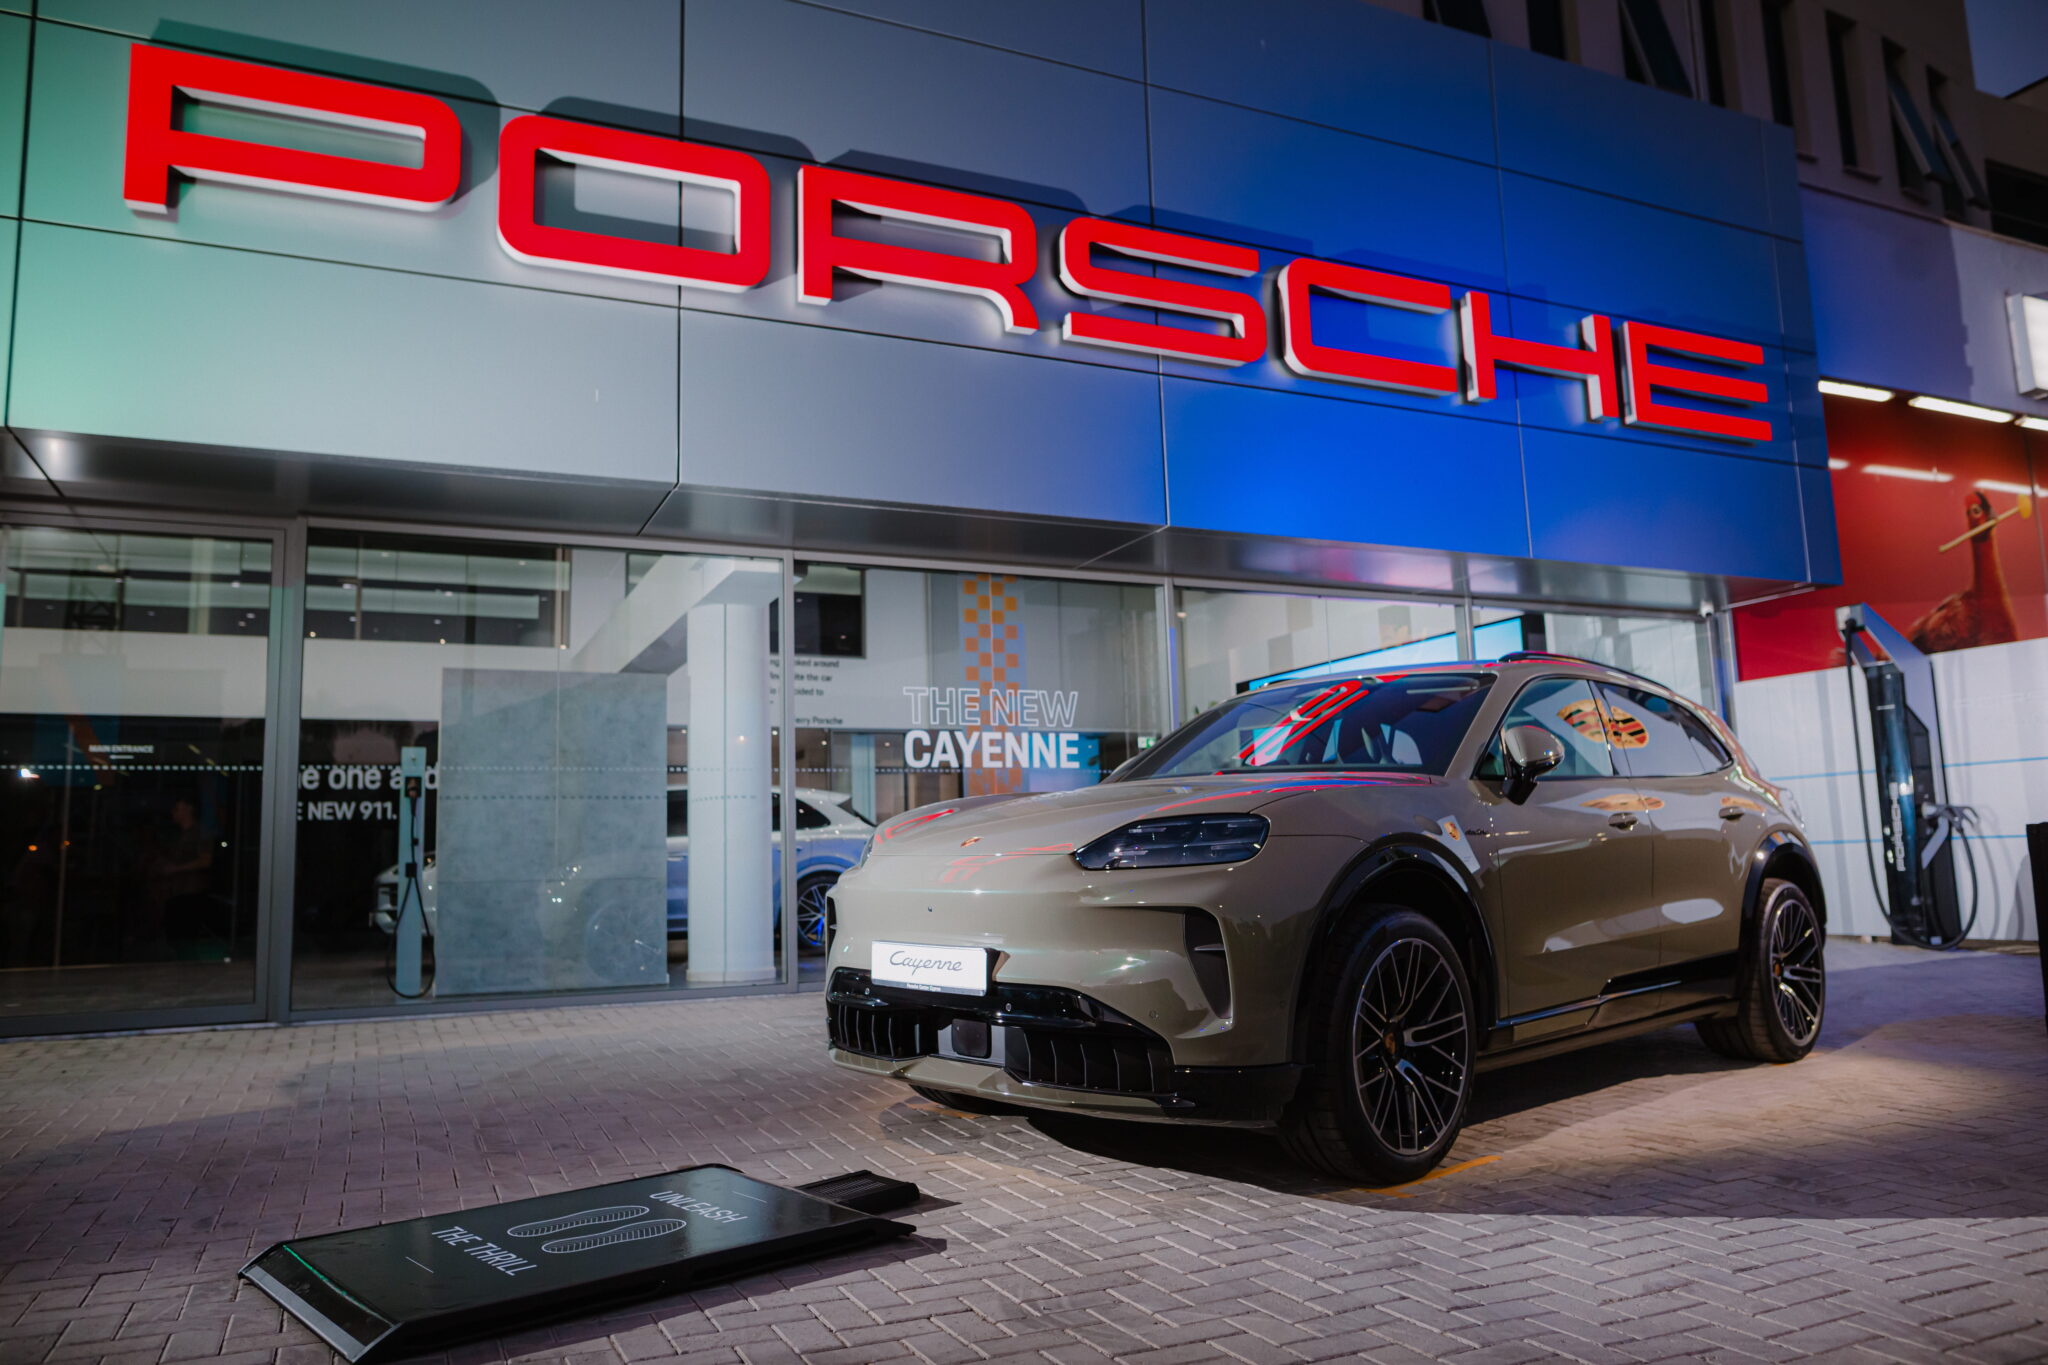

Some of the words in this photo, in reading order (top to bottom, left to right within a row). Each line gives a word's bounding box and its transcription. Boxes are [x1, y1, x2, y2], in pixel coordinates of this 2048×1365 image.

[124, 43, 1773, 443] PORSCHE
[903, 686, 981, 726] THE
[989, 689, 1078, 728] NEW
[88, 744, 111, 753] MAIN
[111, 744, 155, 754] ENTRANCE
[904, 729, 1081, 769] CAYENNE
[328, 768, 382, 790] one
[389, 764, 438, 790] ad
[307, 801, 356, 821] NEW
[359, 801, 398, 821] 911.
[889, 950, 964, 976] Cayenne
[649, 1190, 749, 1224] UNLEASH
[431, 1225, 483, 1247] THE
[463, 1242, 538, 1277] THRILL
